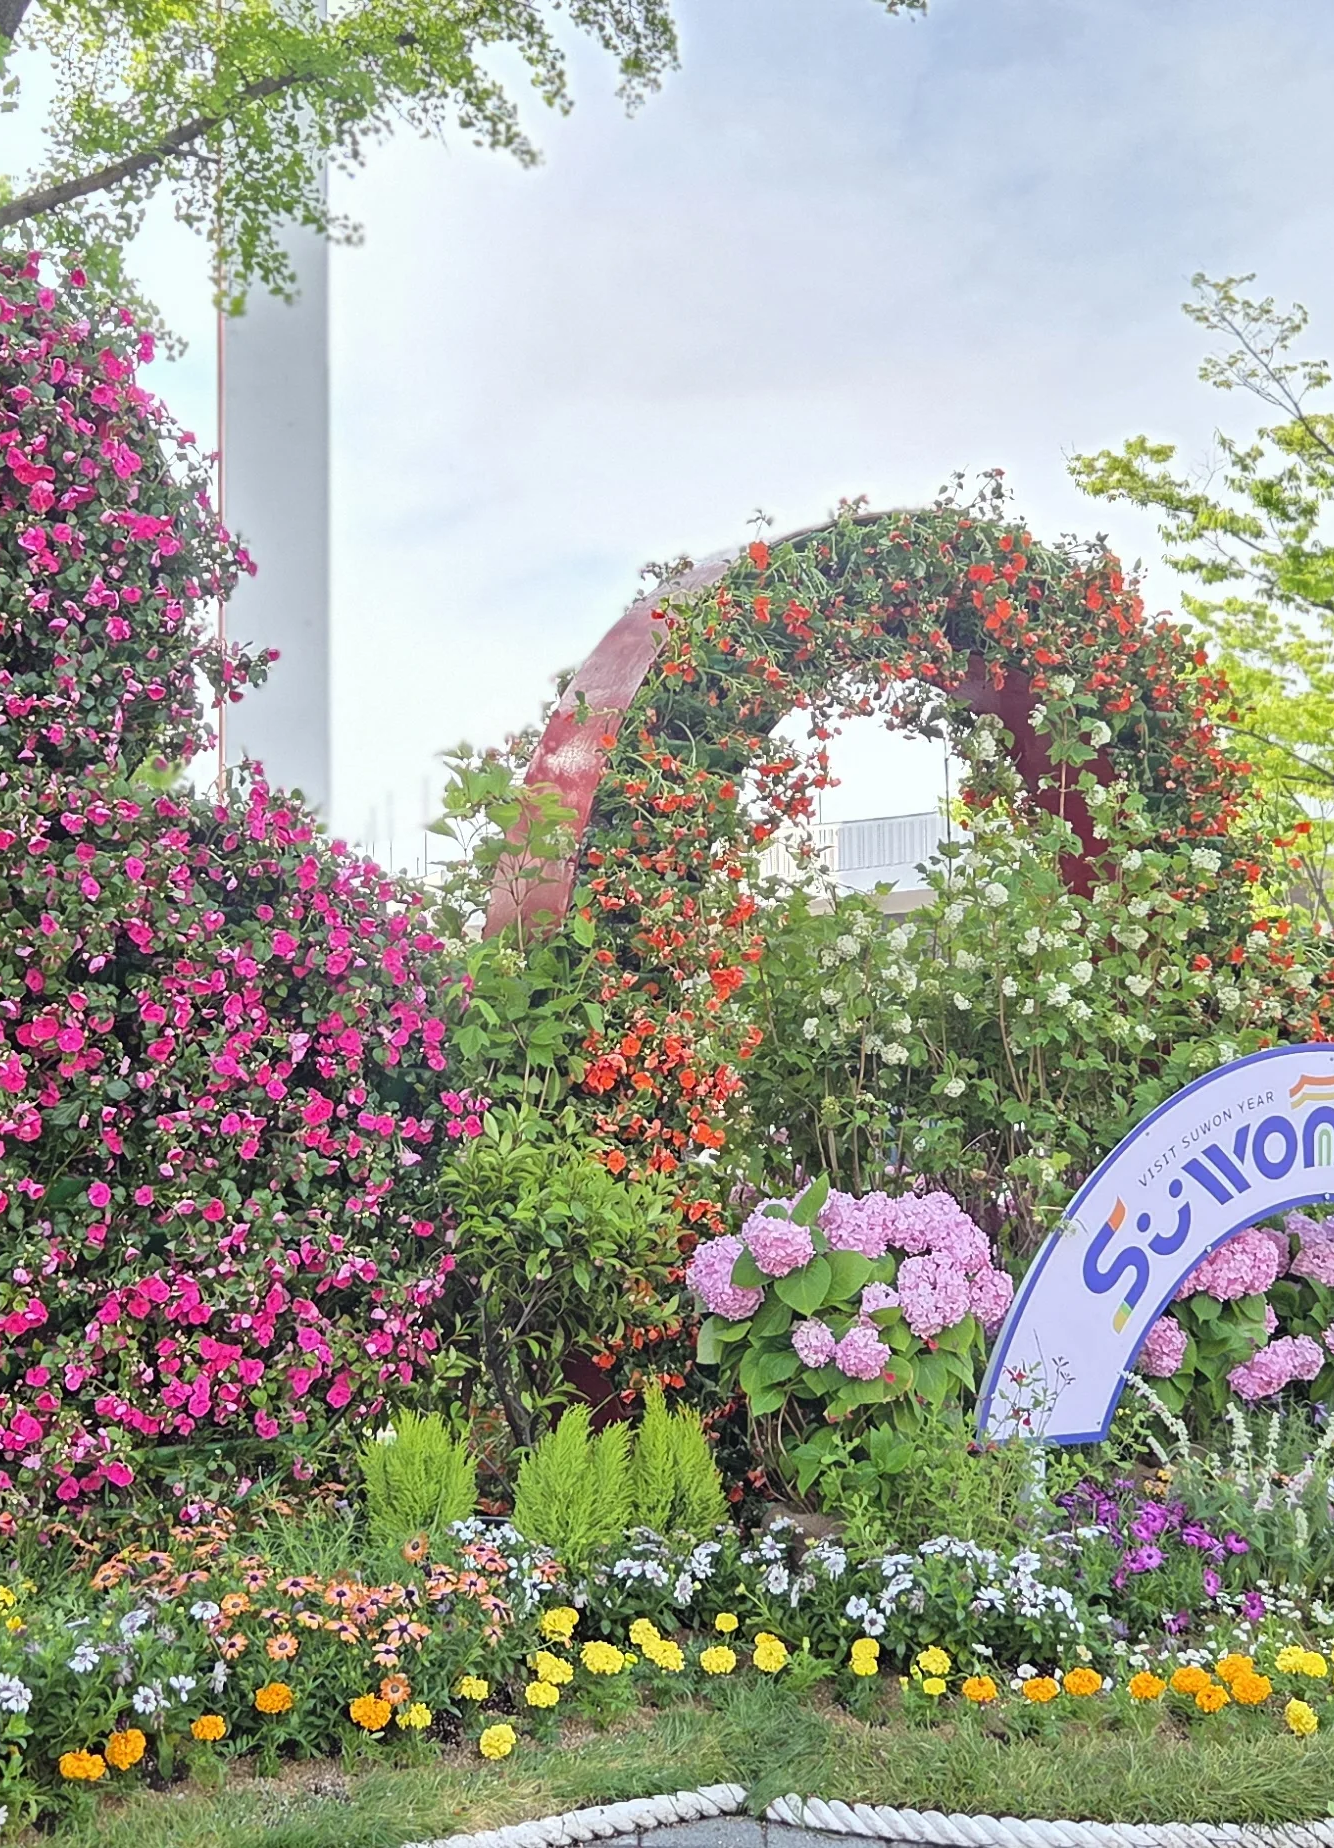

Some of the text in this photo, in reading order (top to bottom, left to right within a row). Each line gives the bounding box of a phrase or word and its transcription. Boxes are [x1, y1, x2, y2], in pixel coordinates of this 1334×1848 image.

[1138, 1090, 1275, 1187] VISIT SUWON YEAR
